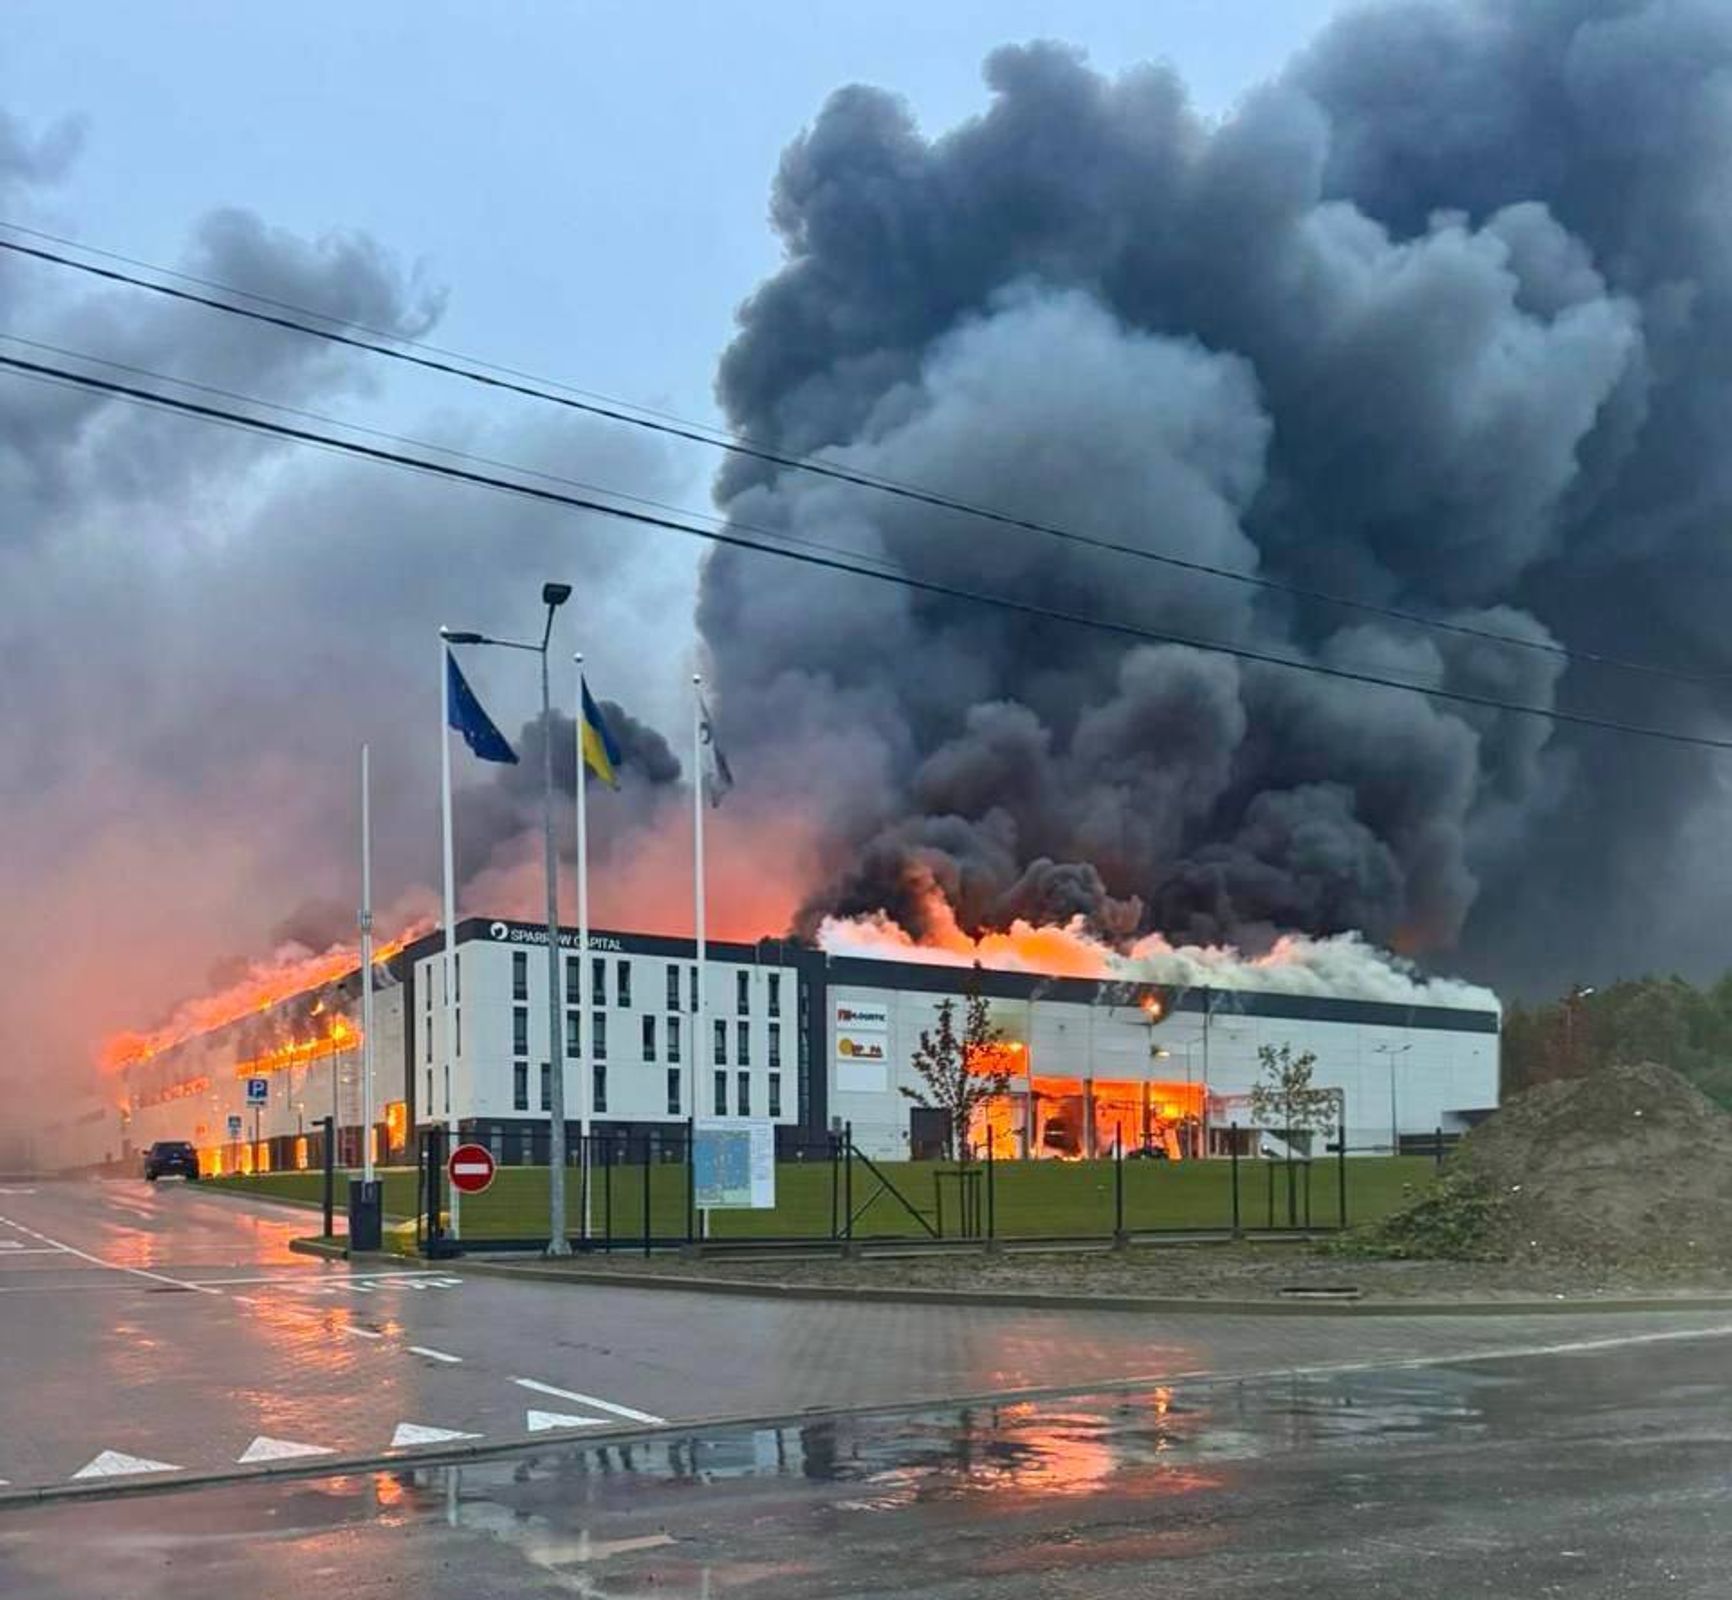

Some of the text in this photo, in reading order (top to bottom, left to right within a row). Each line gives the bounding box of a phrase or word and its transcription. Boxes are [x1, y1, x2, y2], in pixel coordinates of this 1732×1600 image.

[511, 930, 622, 950] SPARRW CPITAL
[252, 1081, 265, 1097] P
